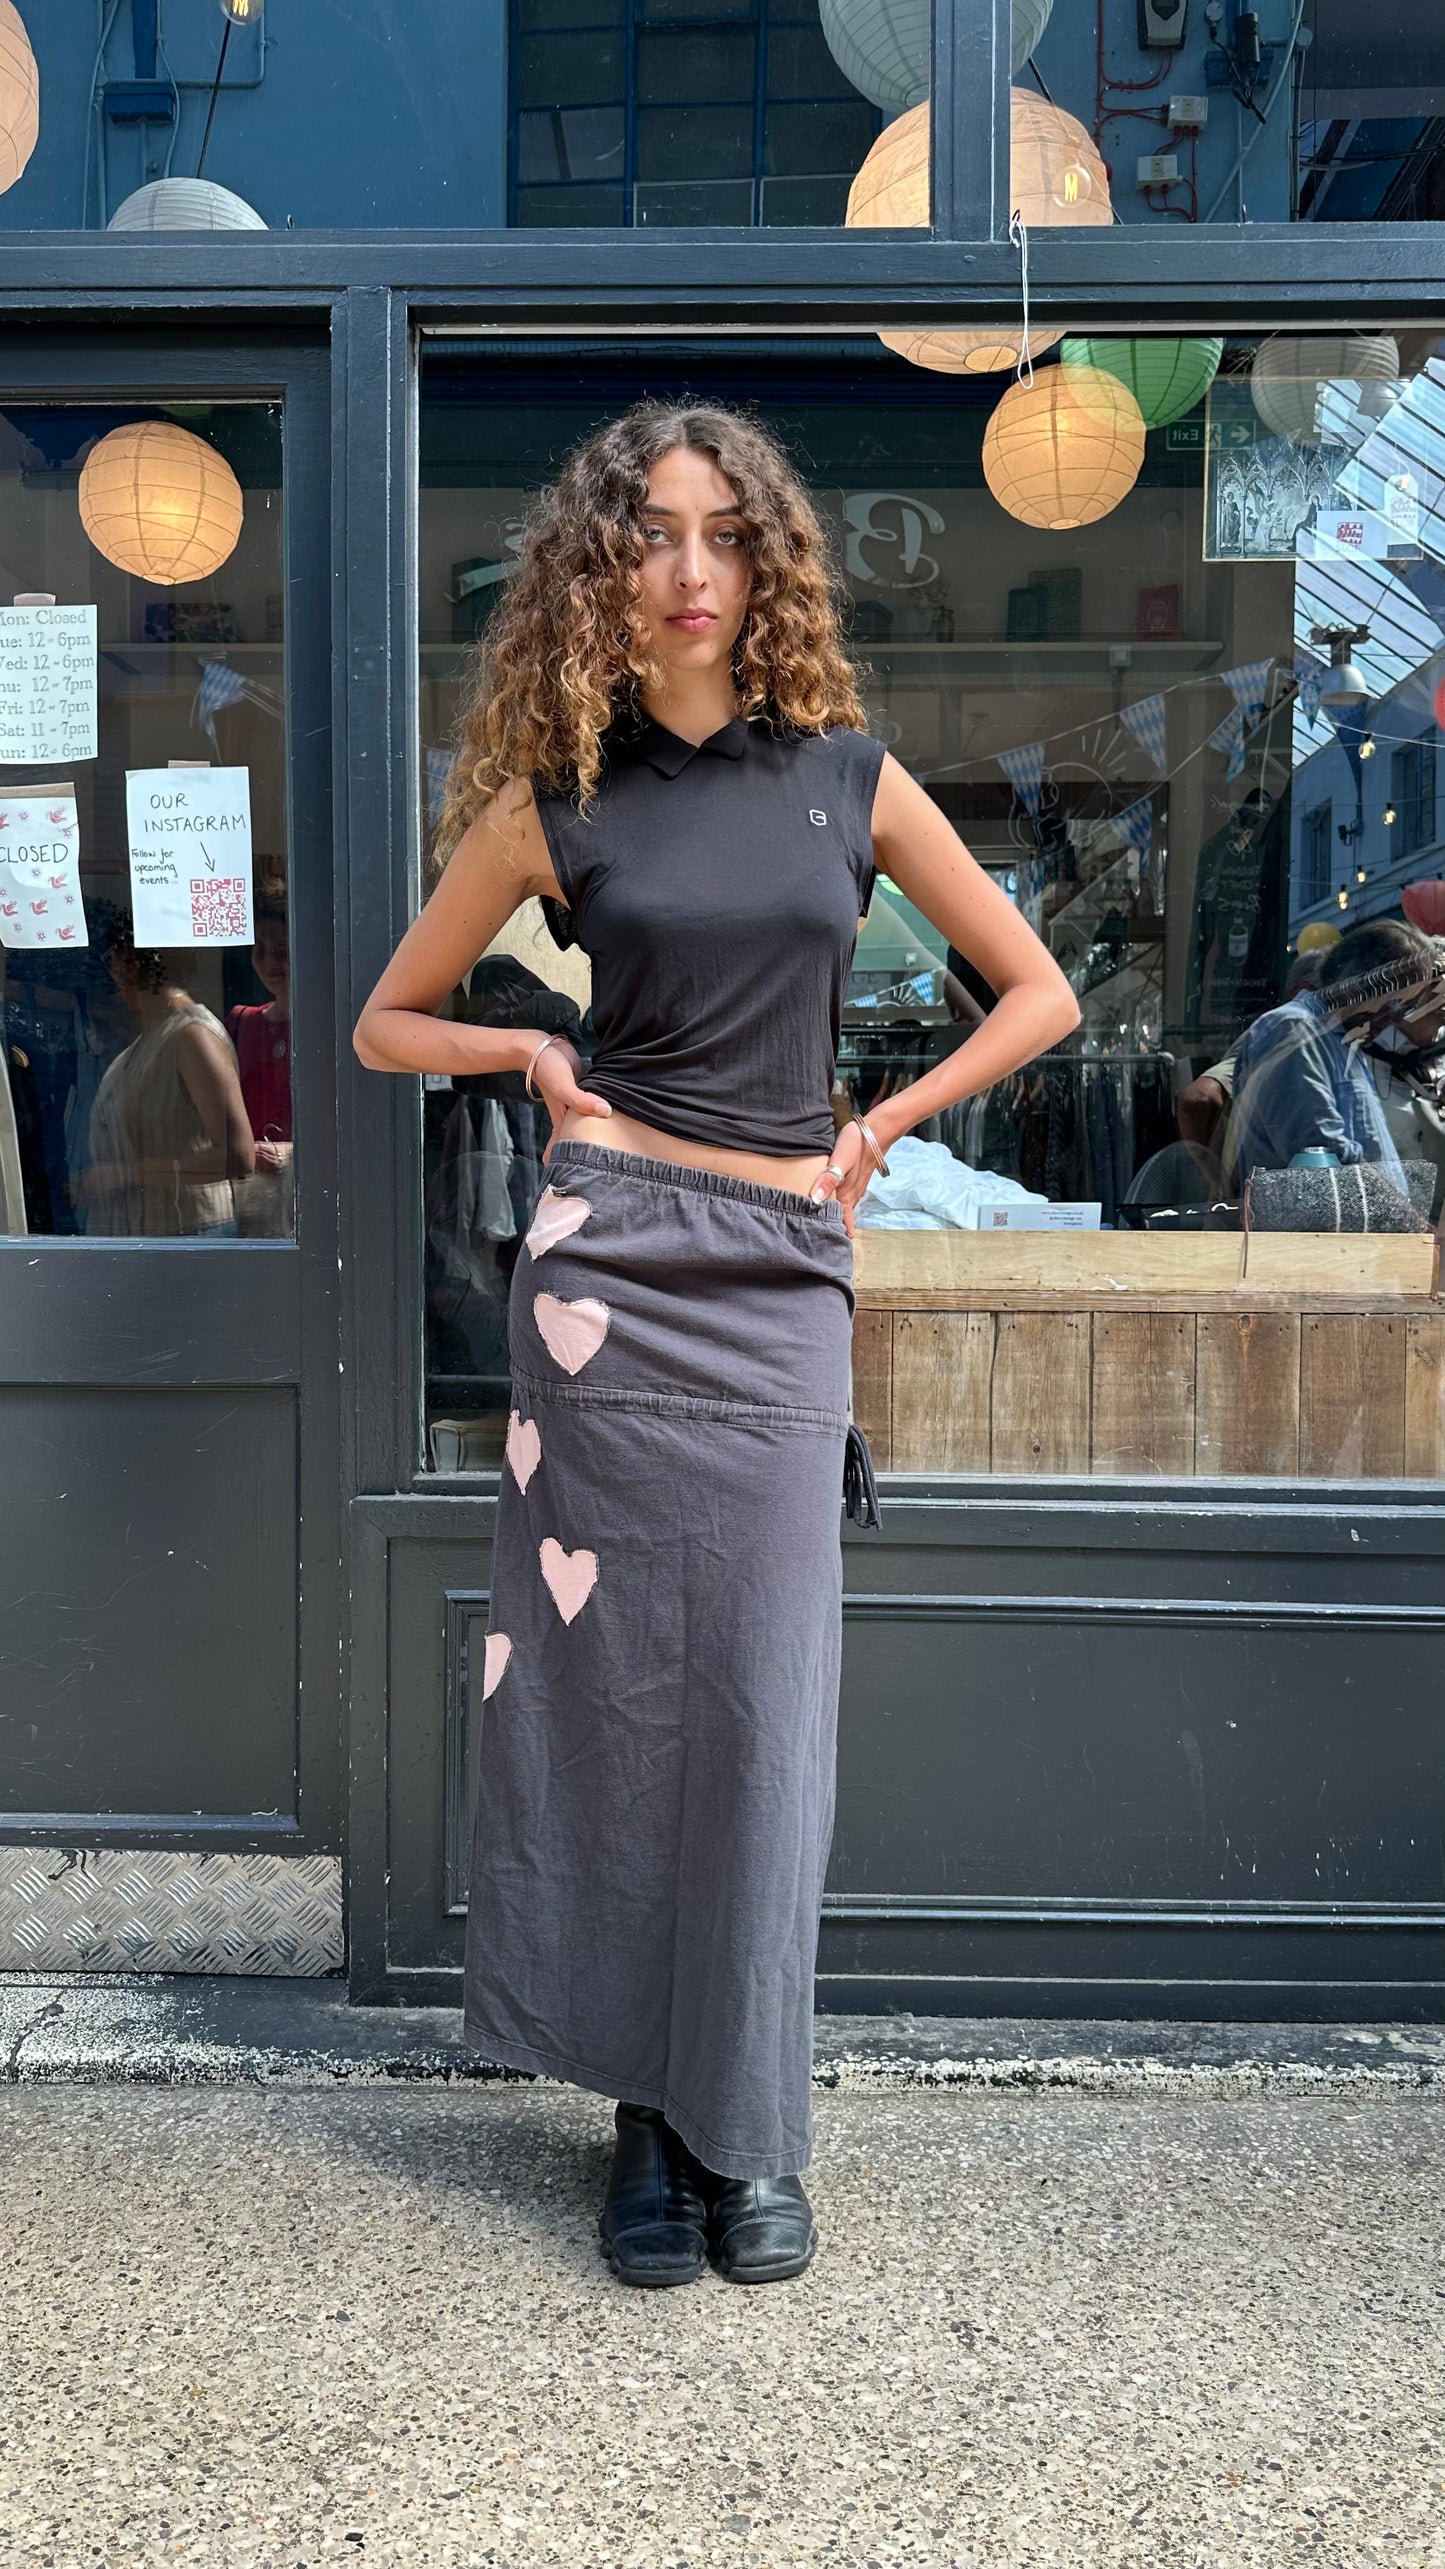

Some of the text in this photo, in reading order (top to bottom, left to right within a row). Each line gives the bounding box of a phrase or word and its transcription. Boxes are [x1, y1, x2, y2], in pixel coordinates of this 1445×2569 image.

[35, 609, 87, 625] Closed
[0, 638, 22, 648] ue:
[0, 749, 26, 759] un:
[150, 792, 189, 809] OUR
[144, 813, 246, 833] INSTAGRAM
[0, 842, 69, 863] CLOSED
[131, 848, 175, 865] Follow for
[134, 862, 179, 878] upcoming
